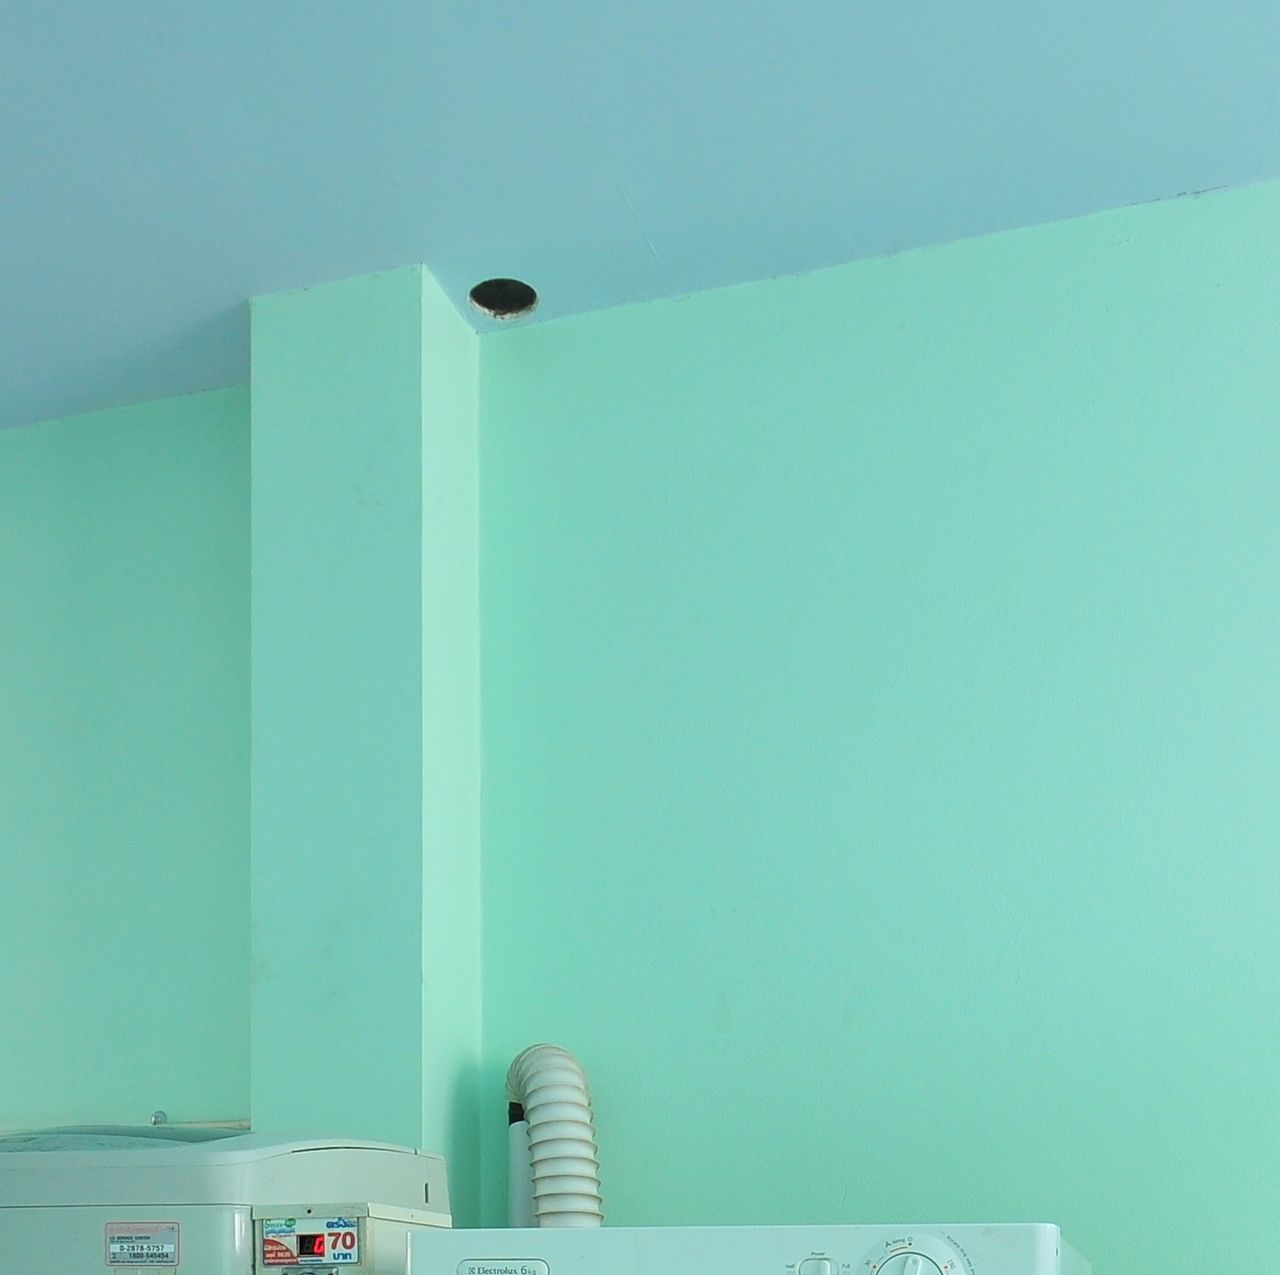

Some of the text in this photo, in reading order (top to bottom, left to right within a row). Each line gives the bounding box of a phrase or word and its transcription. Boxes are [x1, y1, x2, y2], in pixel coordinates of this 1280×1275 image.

[327, 1231, 356, 1250] 70
[332, 1252, 353, 1260] บาท
[477, 1266, 518, 1275] Electrolux
